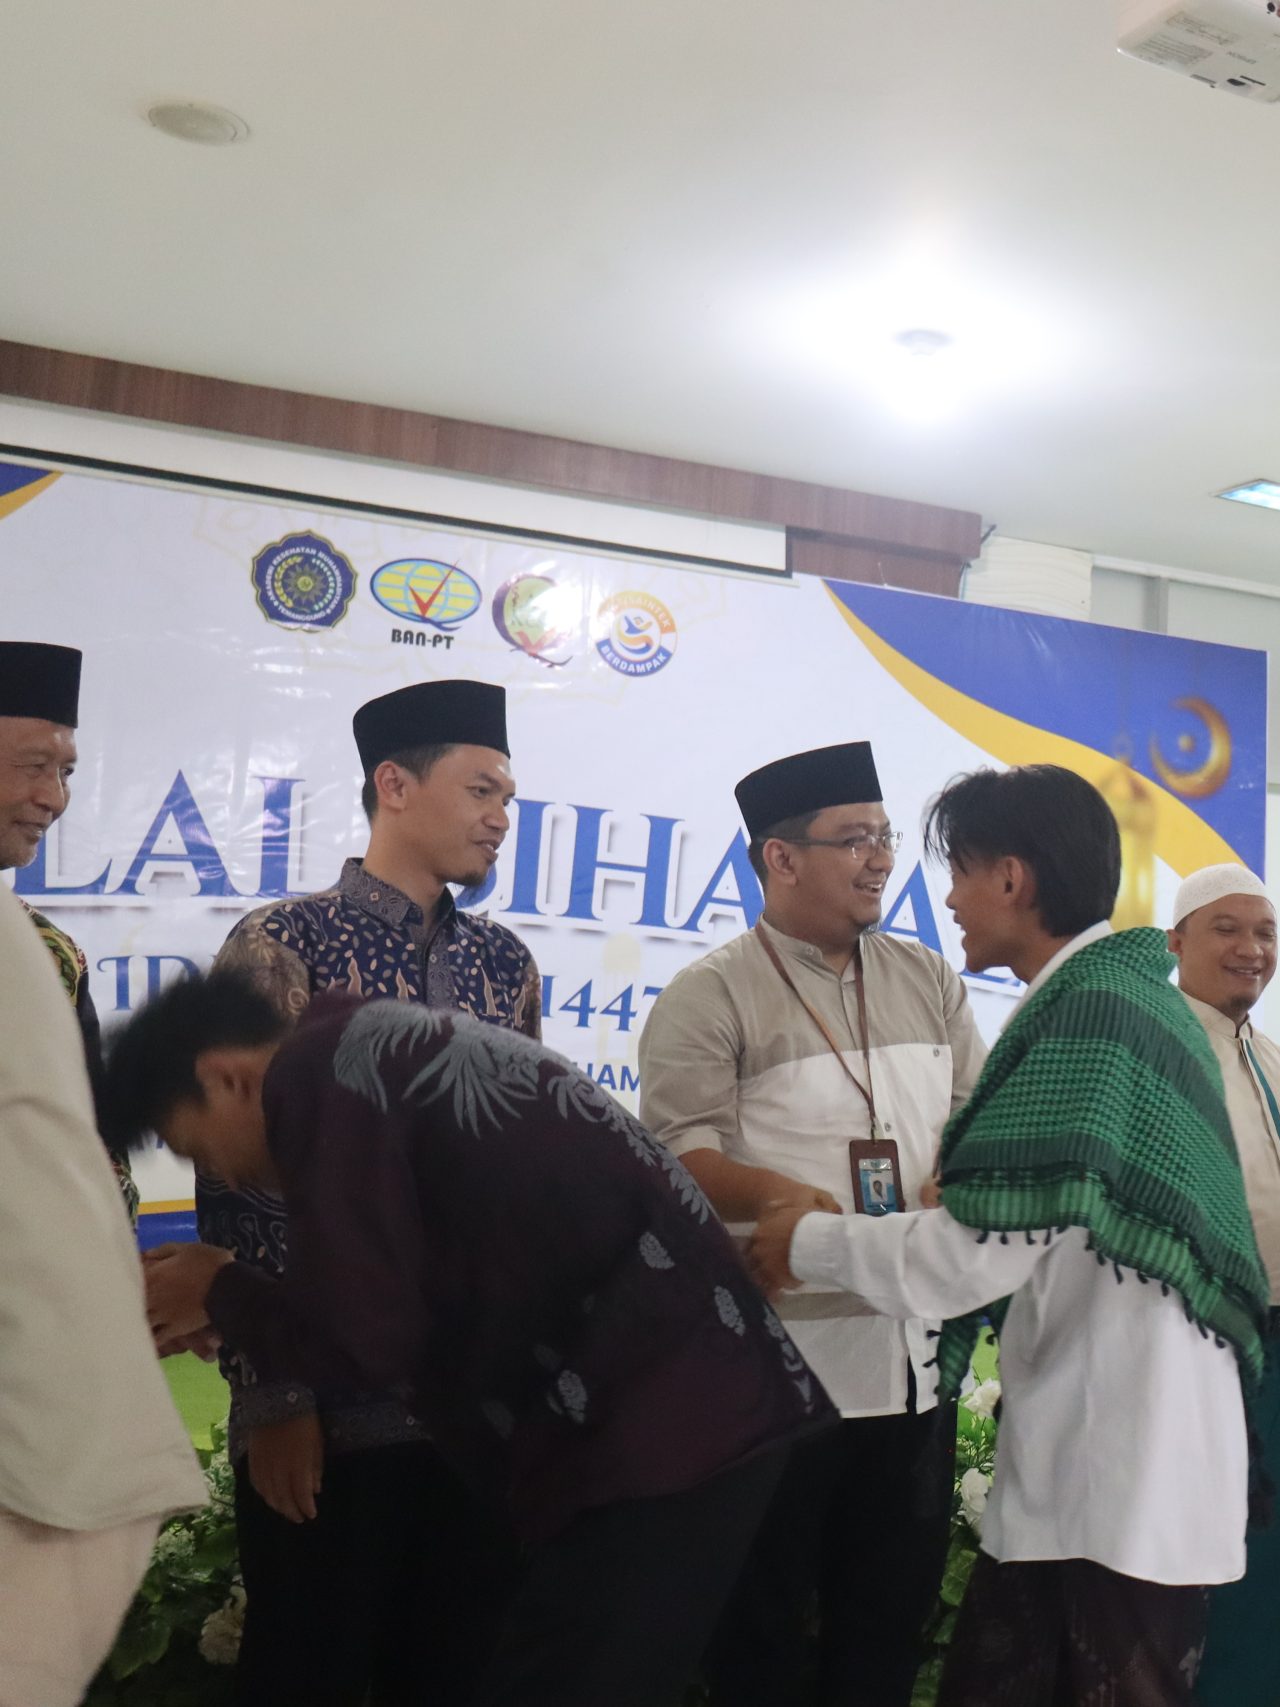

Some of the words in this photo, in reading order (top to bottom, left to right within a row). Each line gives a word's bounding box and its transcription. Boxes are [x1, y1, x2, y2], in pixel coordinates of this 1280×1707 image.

[272, 547, 317, 566] KESEHATAN
[391, 628, 454, 650] BAN-PT
[601, 645, 667, 673] BERDAMPAK
